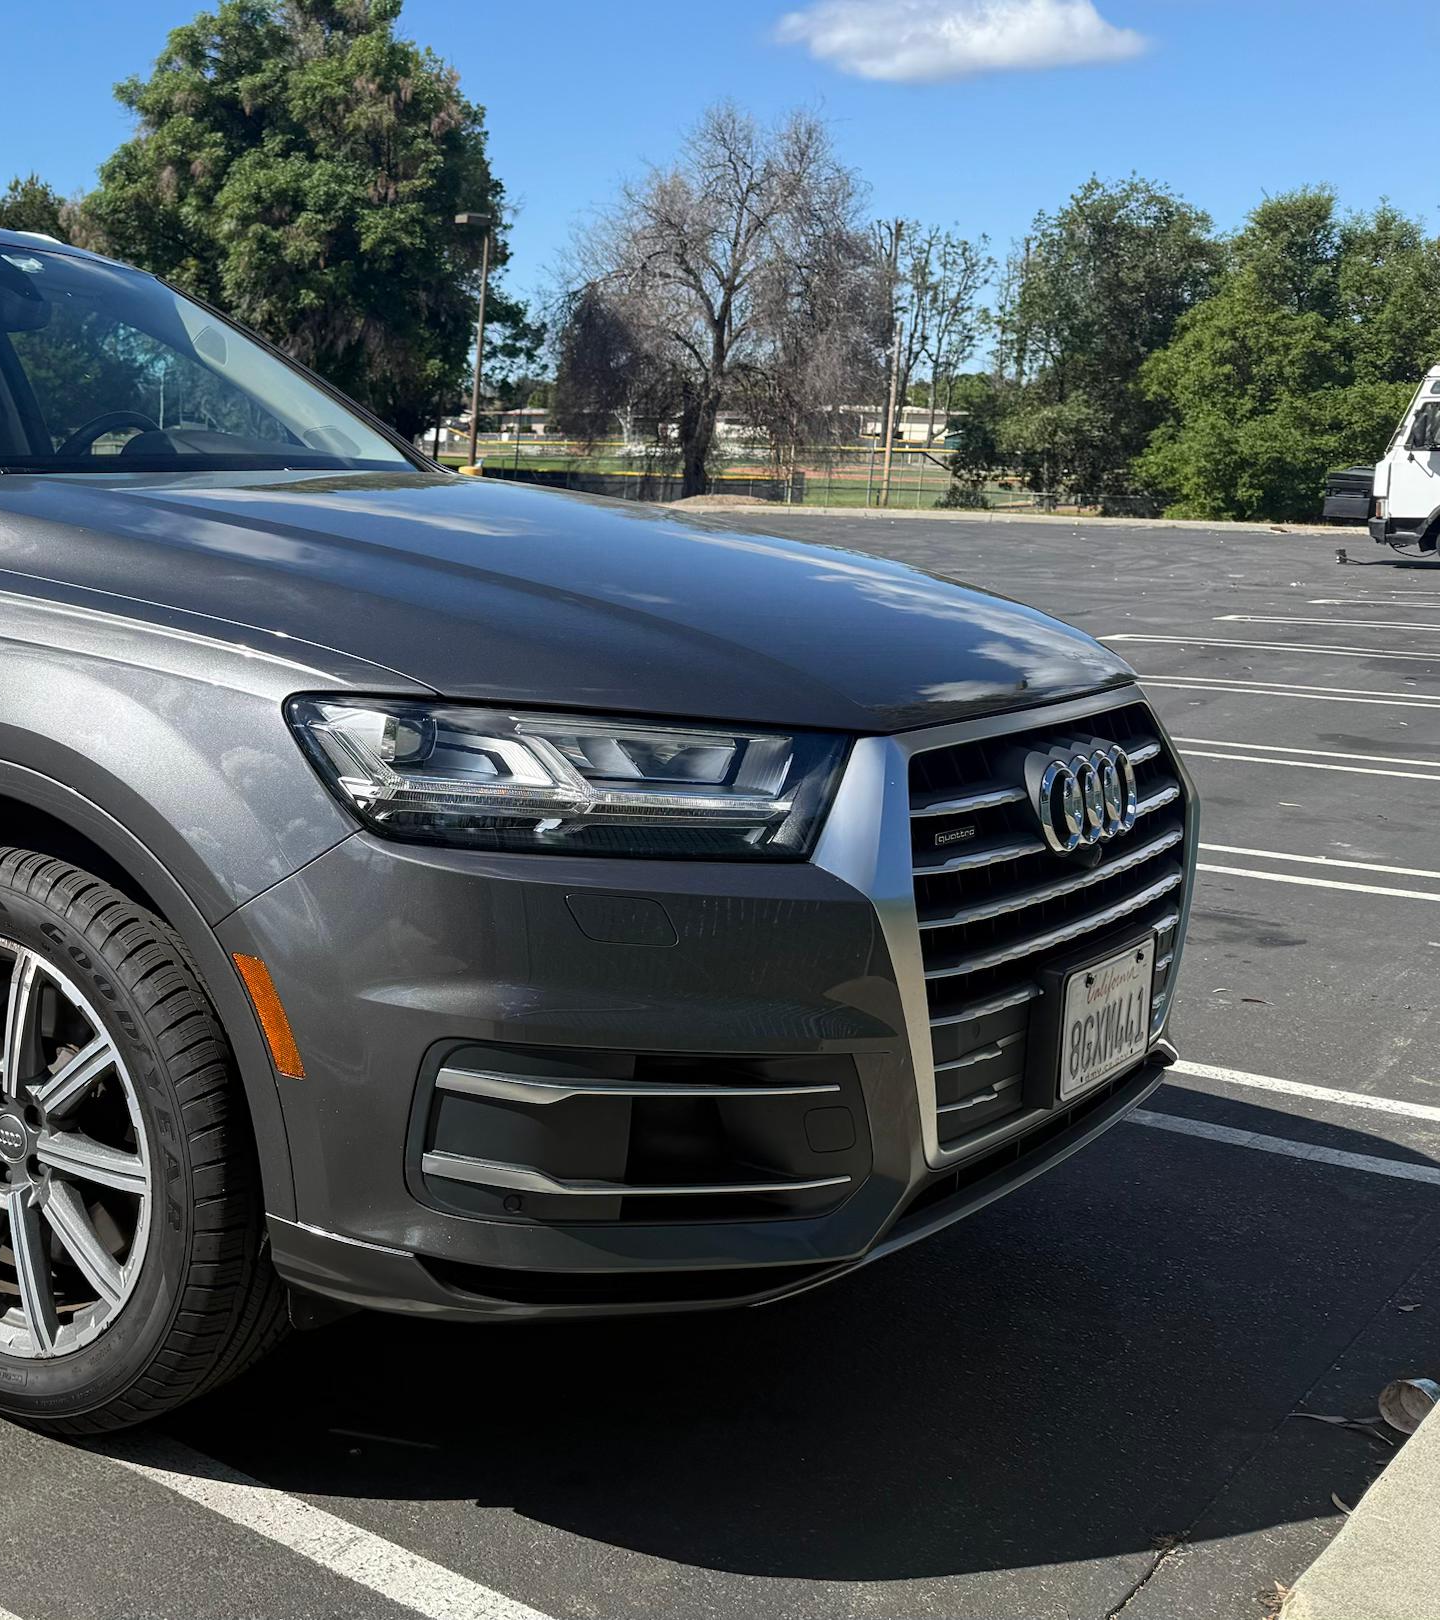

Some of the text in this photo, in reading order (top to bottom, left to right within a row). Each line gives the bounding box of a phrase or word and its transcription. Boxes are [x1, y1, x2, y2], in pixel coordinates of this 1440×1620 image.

[938, 829, 975, 844] quattro
[1086, 965, 1139, 1005] California
[1069, 987, 1144, 1080] 8GXM441
[39, 922, 183, 1232] GOODYEAR
